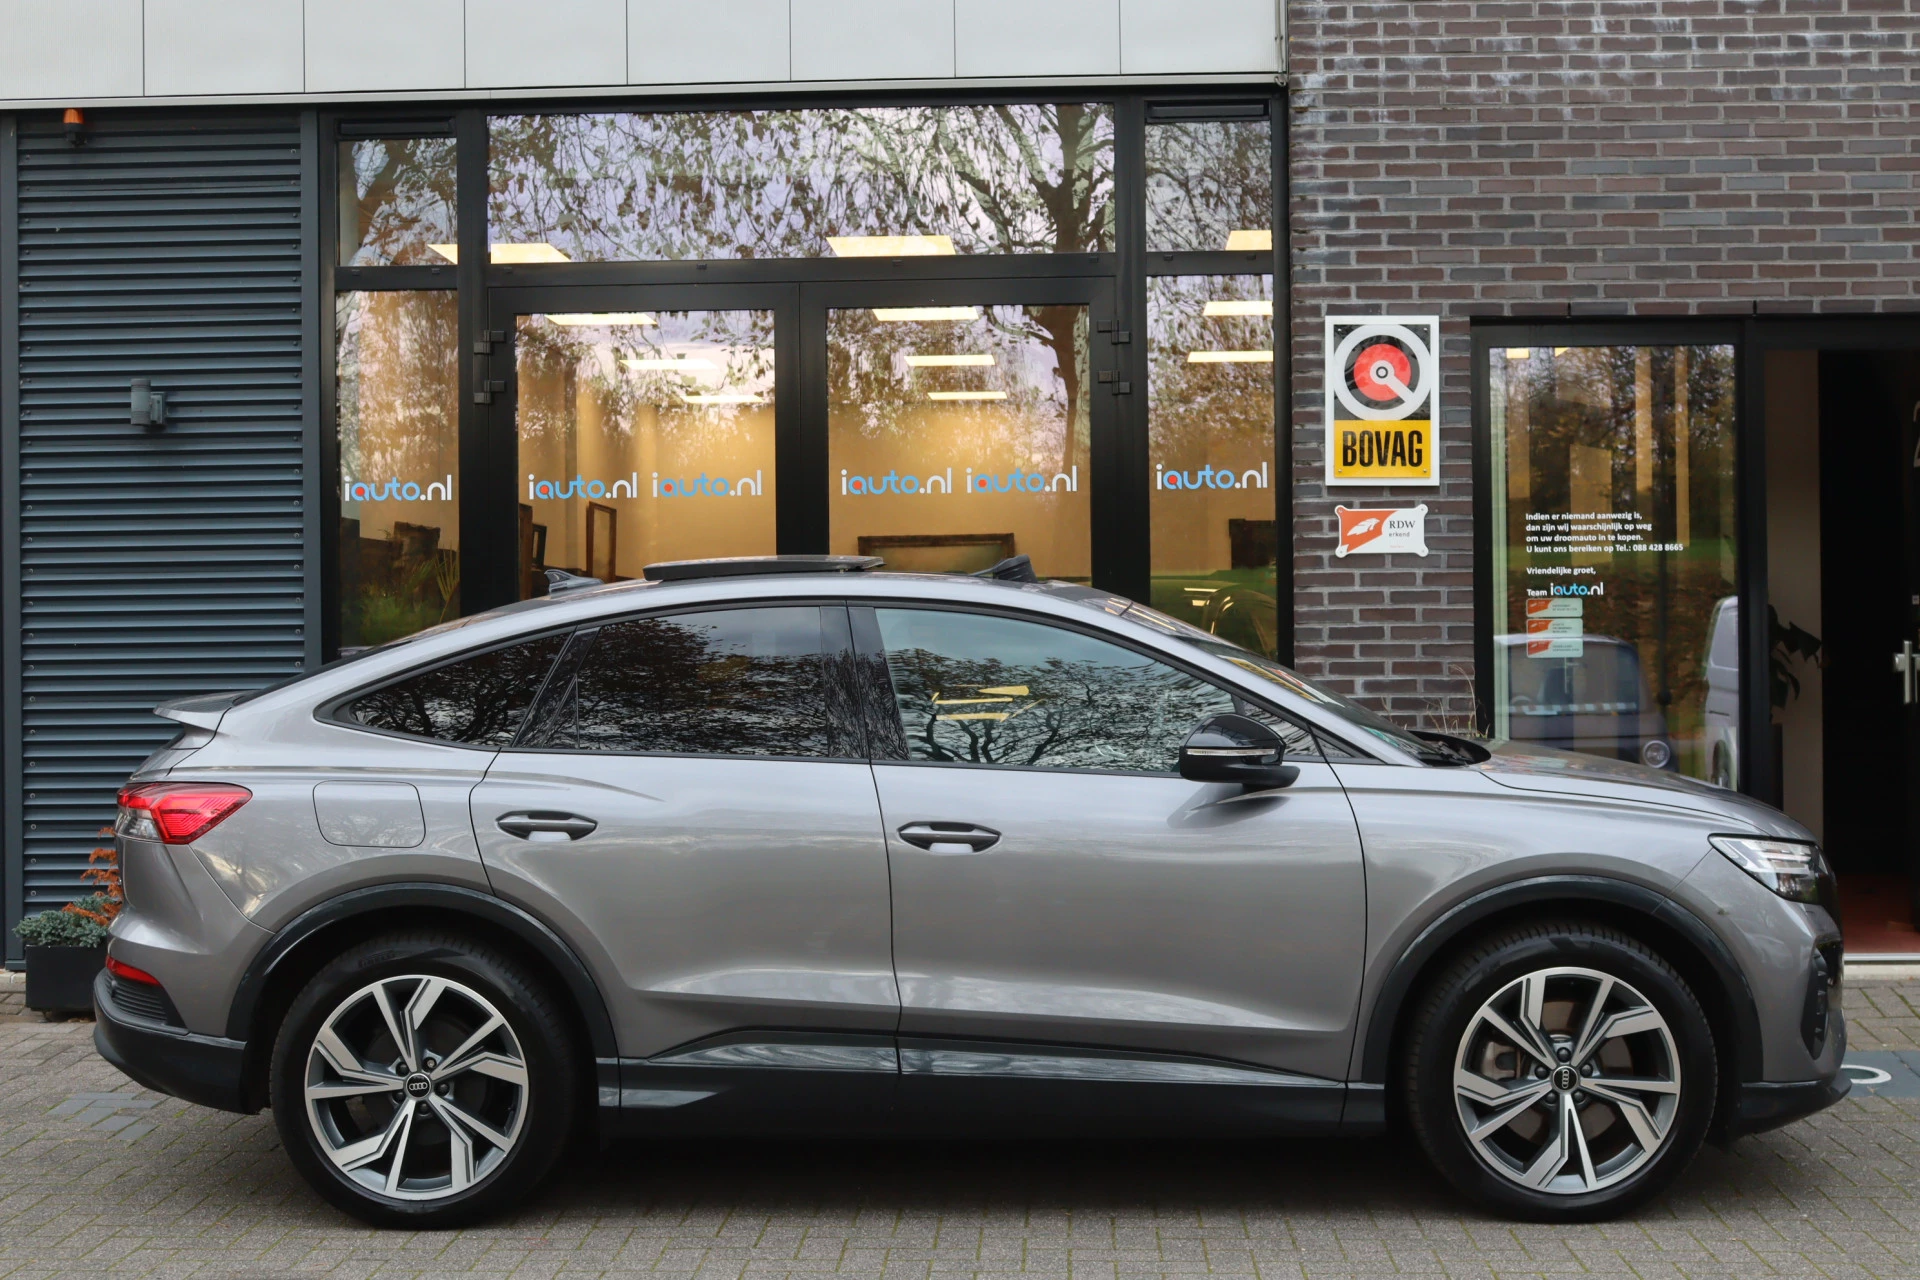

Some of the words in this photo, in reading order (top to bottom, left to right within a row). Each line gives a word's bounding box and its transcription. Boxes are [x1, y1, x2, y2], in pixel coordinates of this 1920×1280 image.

[1342, 430, 1423, 468] BOVAG
[528, 472, 638, 501] iauto.nl
[652, 470, 763, 498] iauto.nl
[841, 467, 952, 496] iauto.nl
[966, 465, 1078, 494] iauto.nl
[1156, 462, 1268, 490] iauto.nl
[344, 474, 453, 502] iauto.nl
[1389, 520, 1416, 529] RDW
[1525, 513, 1550, 521] Indien
[1561, 512, 1596, 520] niemand
[1597, 512, 1633, 521] aanwezig
[1634, 511, 1643, 520] is,
[1525, 524, 1541, 532] dan
[1542, 524, 1556, 533] zijn
[1557, 523, 1570, 533] wij
[1570, 522, 1623, 532] waarschijnlijk
[1624, 523, 1635, 532] op
[1636, 523, 1653, 532] weg
[1525, 535, 1539, 543] om
[1540, 535, 1553, 543] uw
[1554, 534, 1597, 543] droomauto
[1598, 534, 1607, 542] in
[1607, 533, 1616, 542] te
[1617, 533, 1644, 543] kopen.
[1526, 545, 1533, 553] U
[1534, 545, 1552, 553] kunt
[1553, 545, 1568, 553] ons
[1569, 544, 1602, 553] bereiken
[1603, 545, 1614, 554] op
[1615, 544, 1632, 553] Tel.:
[1632, 543, 1648, 552] 088
[1648, 543, 1664, 552] 428
[1664, 543, 1684, 552] 8665
[1526, 566, 1572, 576] Vriendelijke
[1573, 566, 1597, 576] groet,
[1526, 588, 1548, 597] Team
[1550, 581, 1604, 596] iauto.nl
